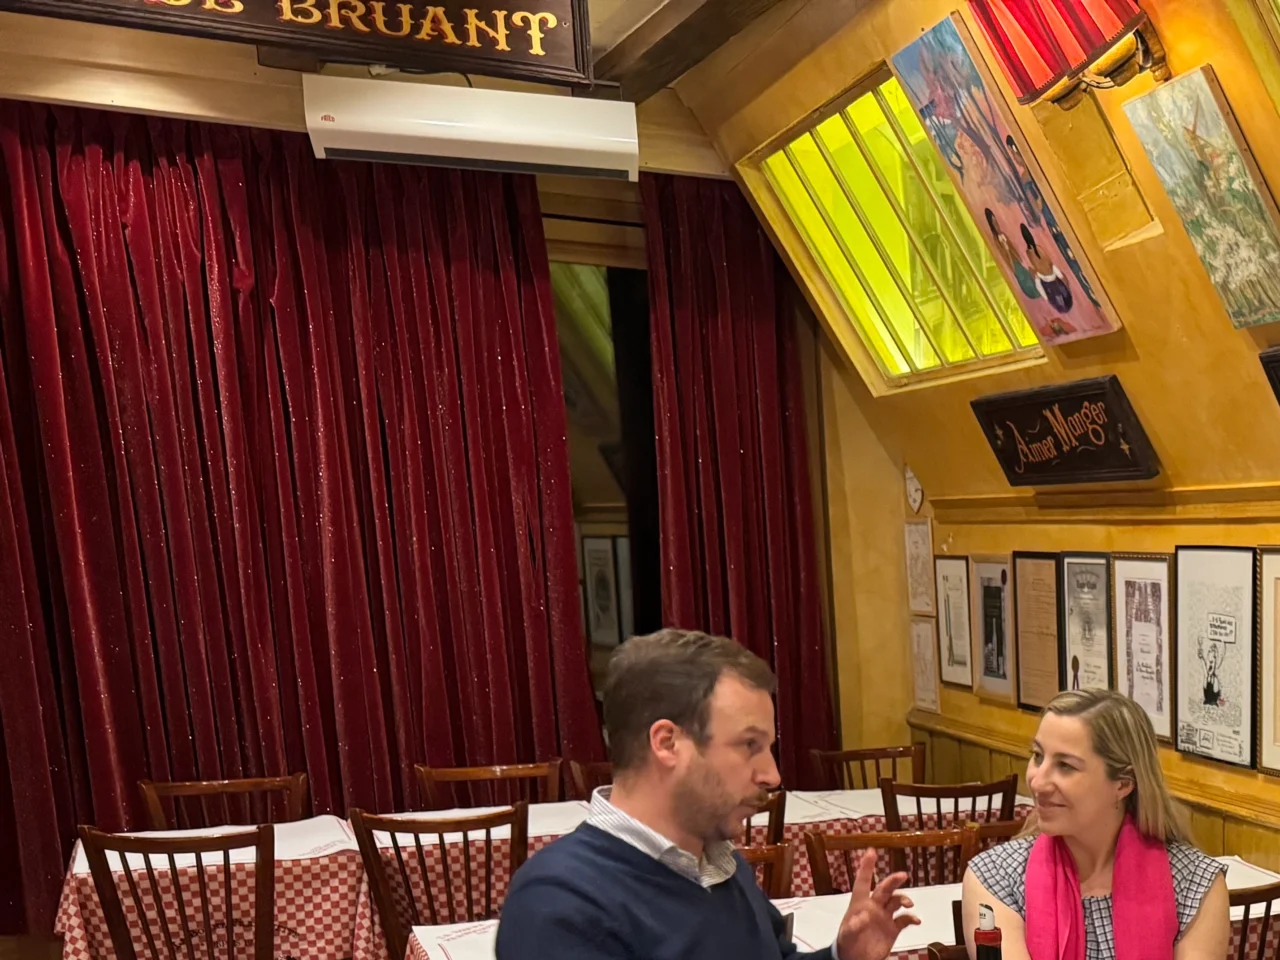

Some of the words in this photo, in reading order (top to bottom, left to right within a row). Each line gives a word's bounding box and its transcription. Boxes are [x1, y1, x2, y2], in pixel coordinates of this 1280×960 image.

[277, 0, 558, 56] BRUANT
[1006, 420, 1058, 474] Aimer
[1042, 401, 1108, 452] Manger
